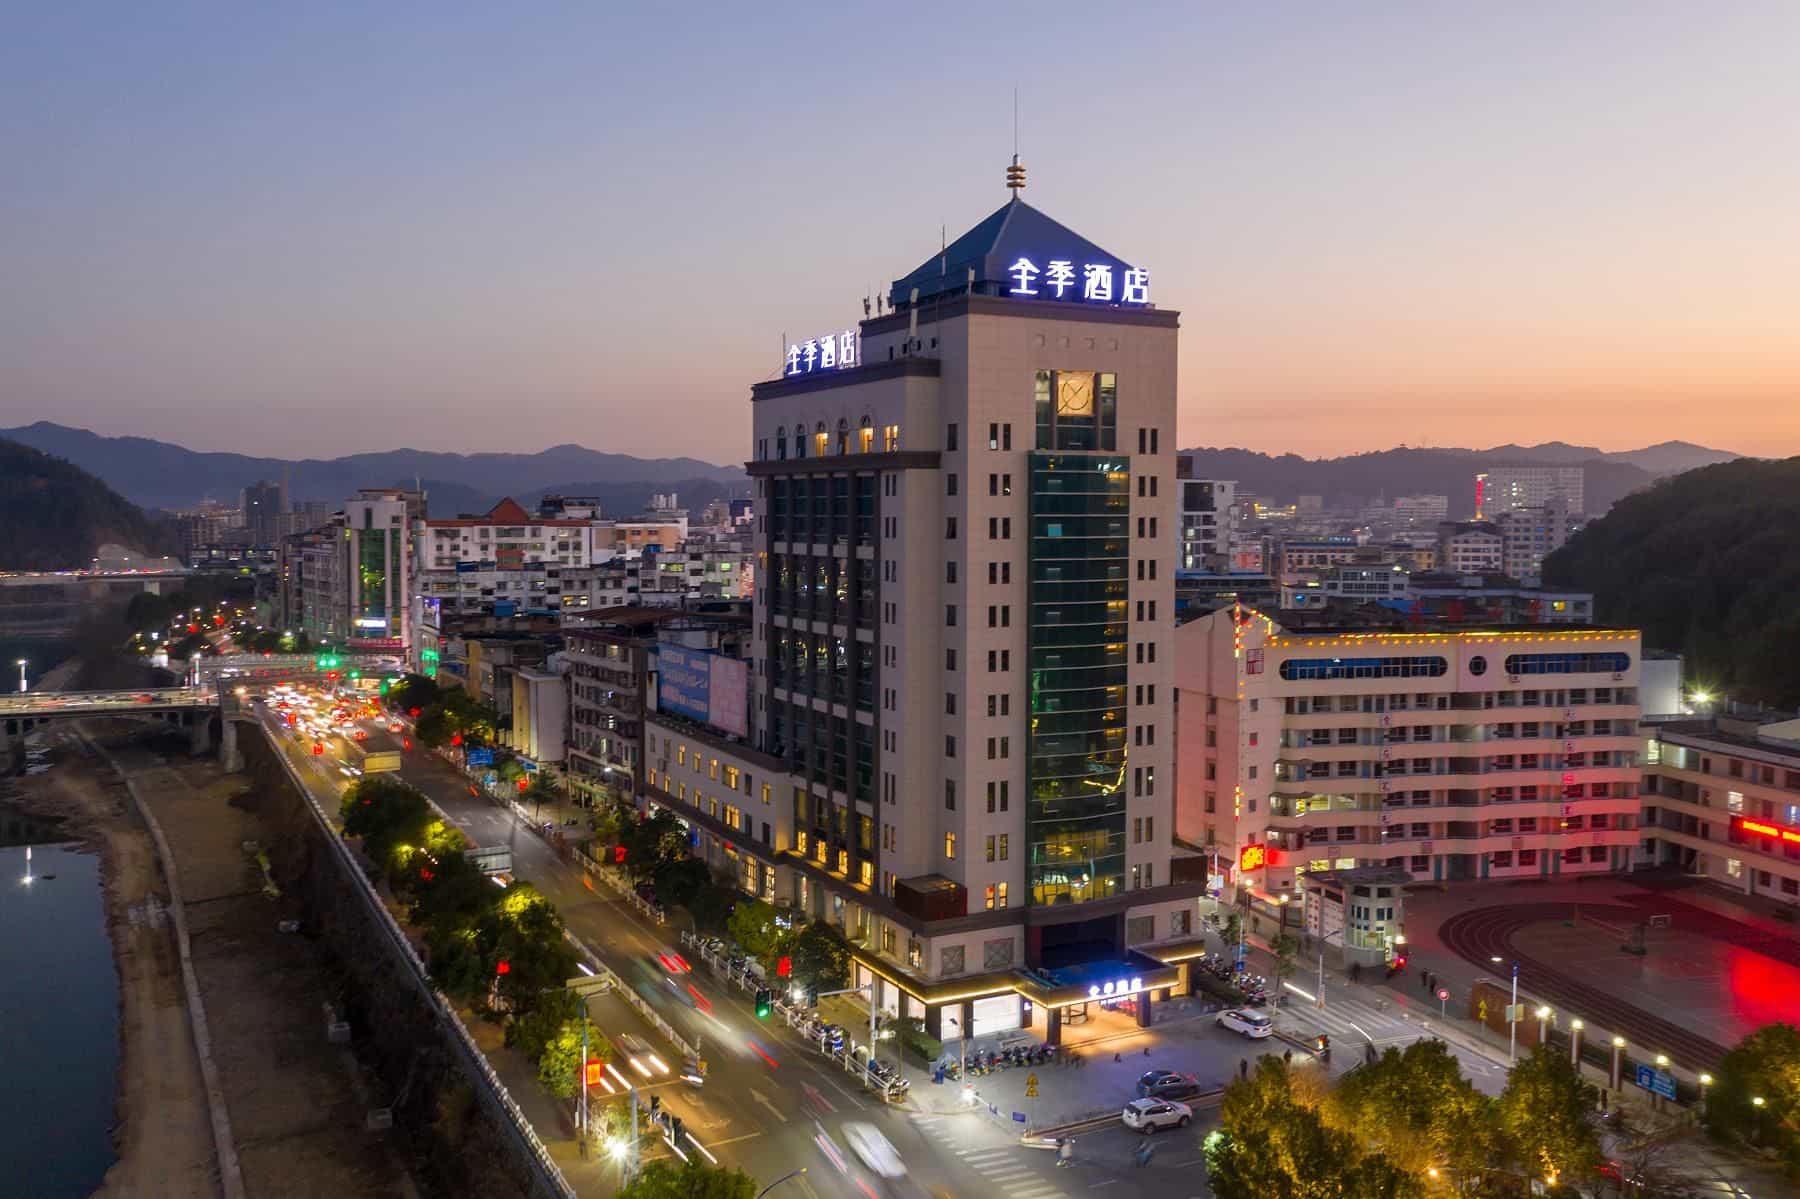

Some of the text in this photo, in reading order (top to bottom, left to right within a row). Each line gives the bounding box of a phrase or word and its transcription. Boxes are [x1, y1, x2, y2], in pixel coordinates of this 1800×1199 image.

[1008, 257, 1150, 303] 全季酒店
[787, 330, 856, 375] 全季酒店
